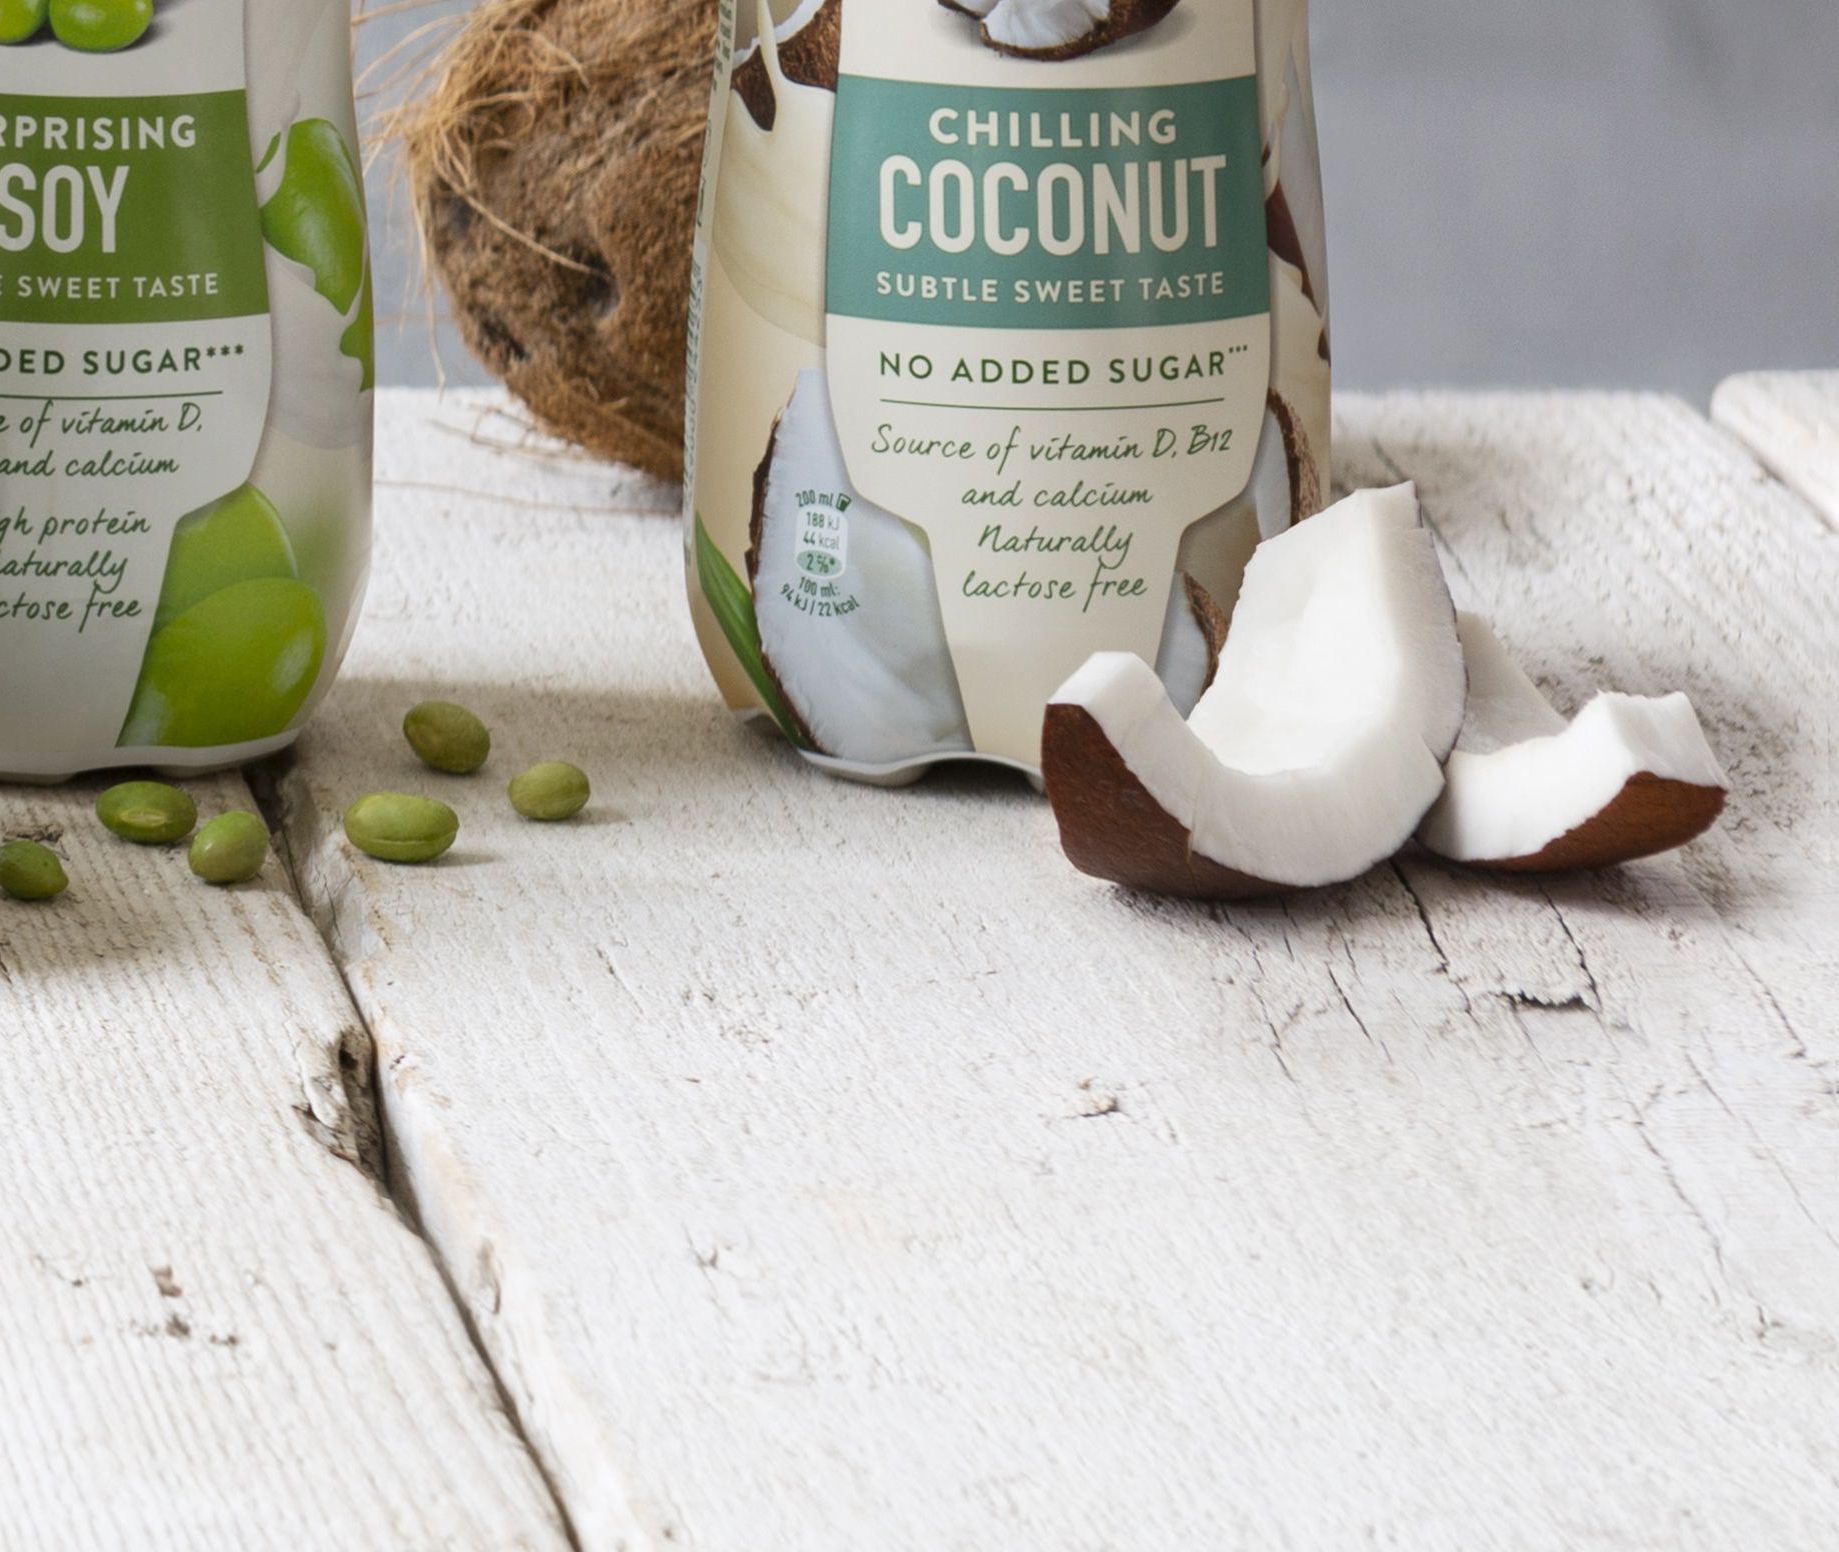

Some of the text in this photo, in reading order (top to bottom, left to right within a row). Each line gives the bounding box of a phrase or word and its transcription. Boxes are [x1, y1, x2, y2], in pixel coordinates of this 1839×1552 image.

[929, 107, 1177, 148] CHILLING
[878, 153, 1227, 257] COCONUT
[17, 274, 120, 299] SWEET
[133, 272, 219, 298] TASTE
[876, 270, 1224, 304] SUBTLE SWEET TASTE
[880, 351, 933, 380] NO
[951, 358, 1091, 386] ADDED
[19, 399, 54, 448] of
[61, 409, 169, 434] vitamin
[65, 452, 180, 478] calcium
[870, 424, 975, 460] Source
[986, 425, 1022, 475] of
[1030, 434, 1144, 460] vitamin
[1187, 424, 1232, 456] B12
[960, 481, 1153, 509] and calcium
[40, 510, 151, 546] protein
[977, 524, 1133, 572] Naturally
[78, 579, 143, 634] free
[961, 559, 1149, 613] lactose free
